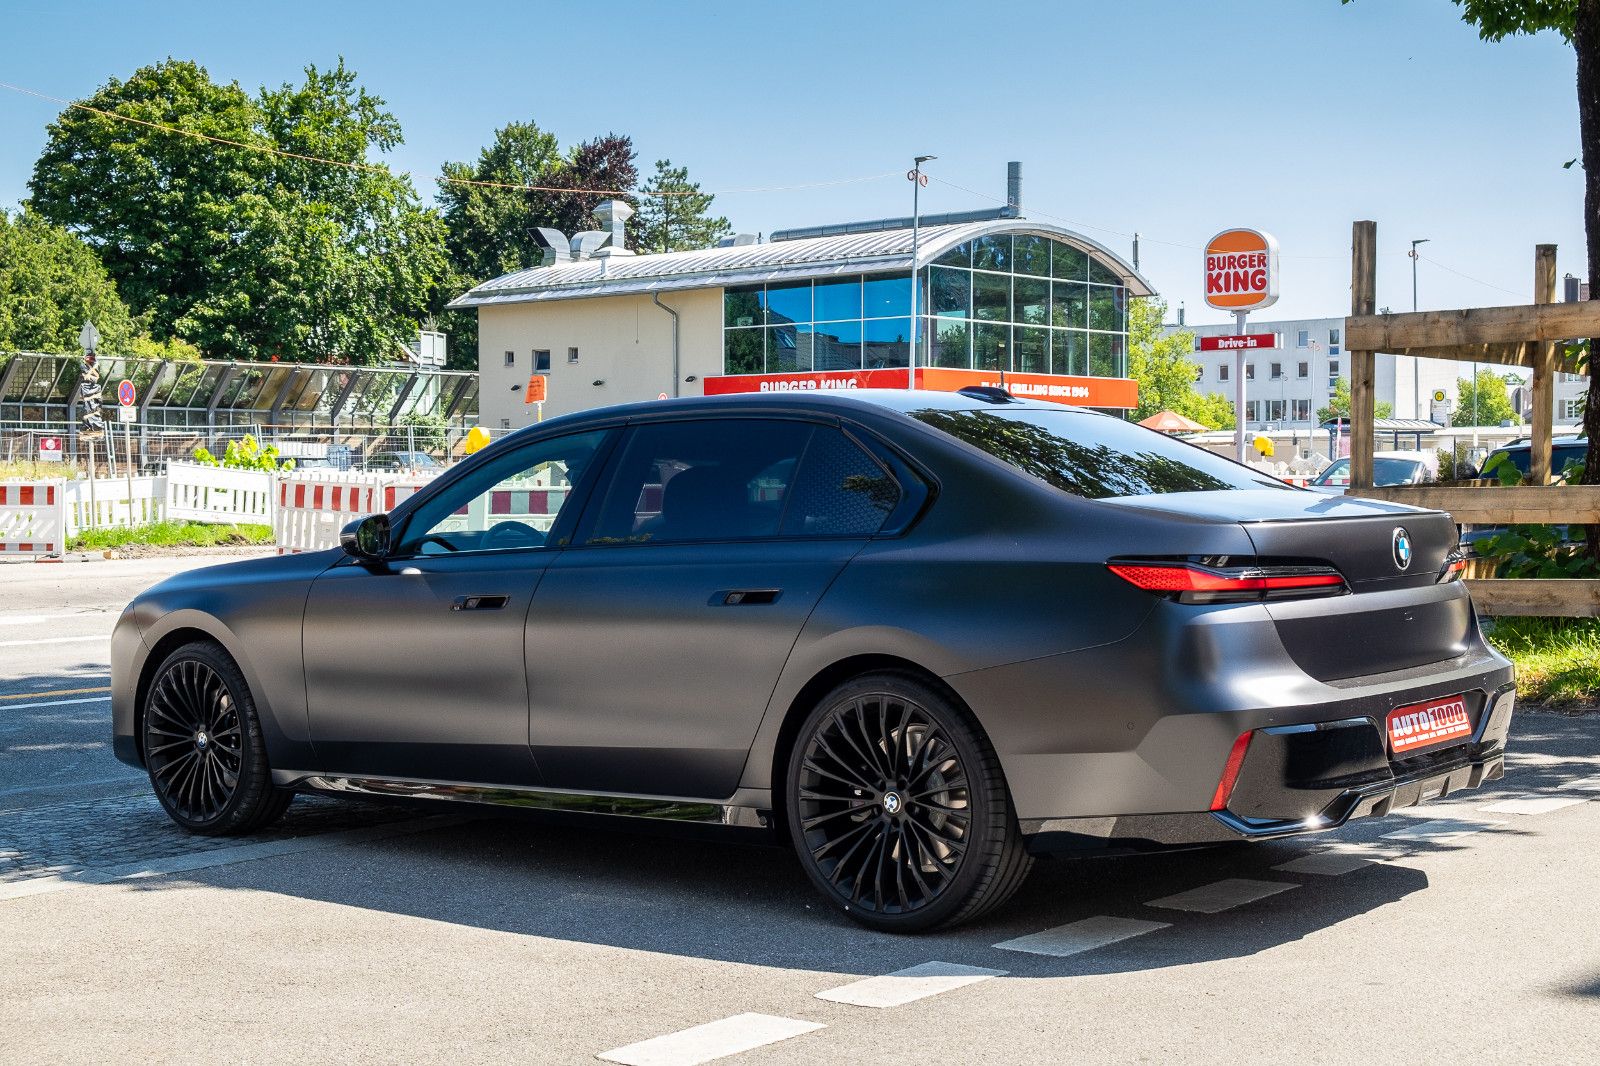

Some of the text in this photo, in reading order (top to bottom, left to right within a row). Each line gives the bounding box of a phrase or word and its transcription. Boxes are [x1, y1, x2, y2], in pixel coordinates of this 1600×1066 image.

[1207, 253, 1267, 272] BURGER
[1207, 269, 1267, 294] KING
[1218, 336, 1258, 349] Drive-in
